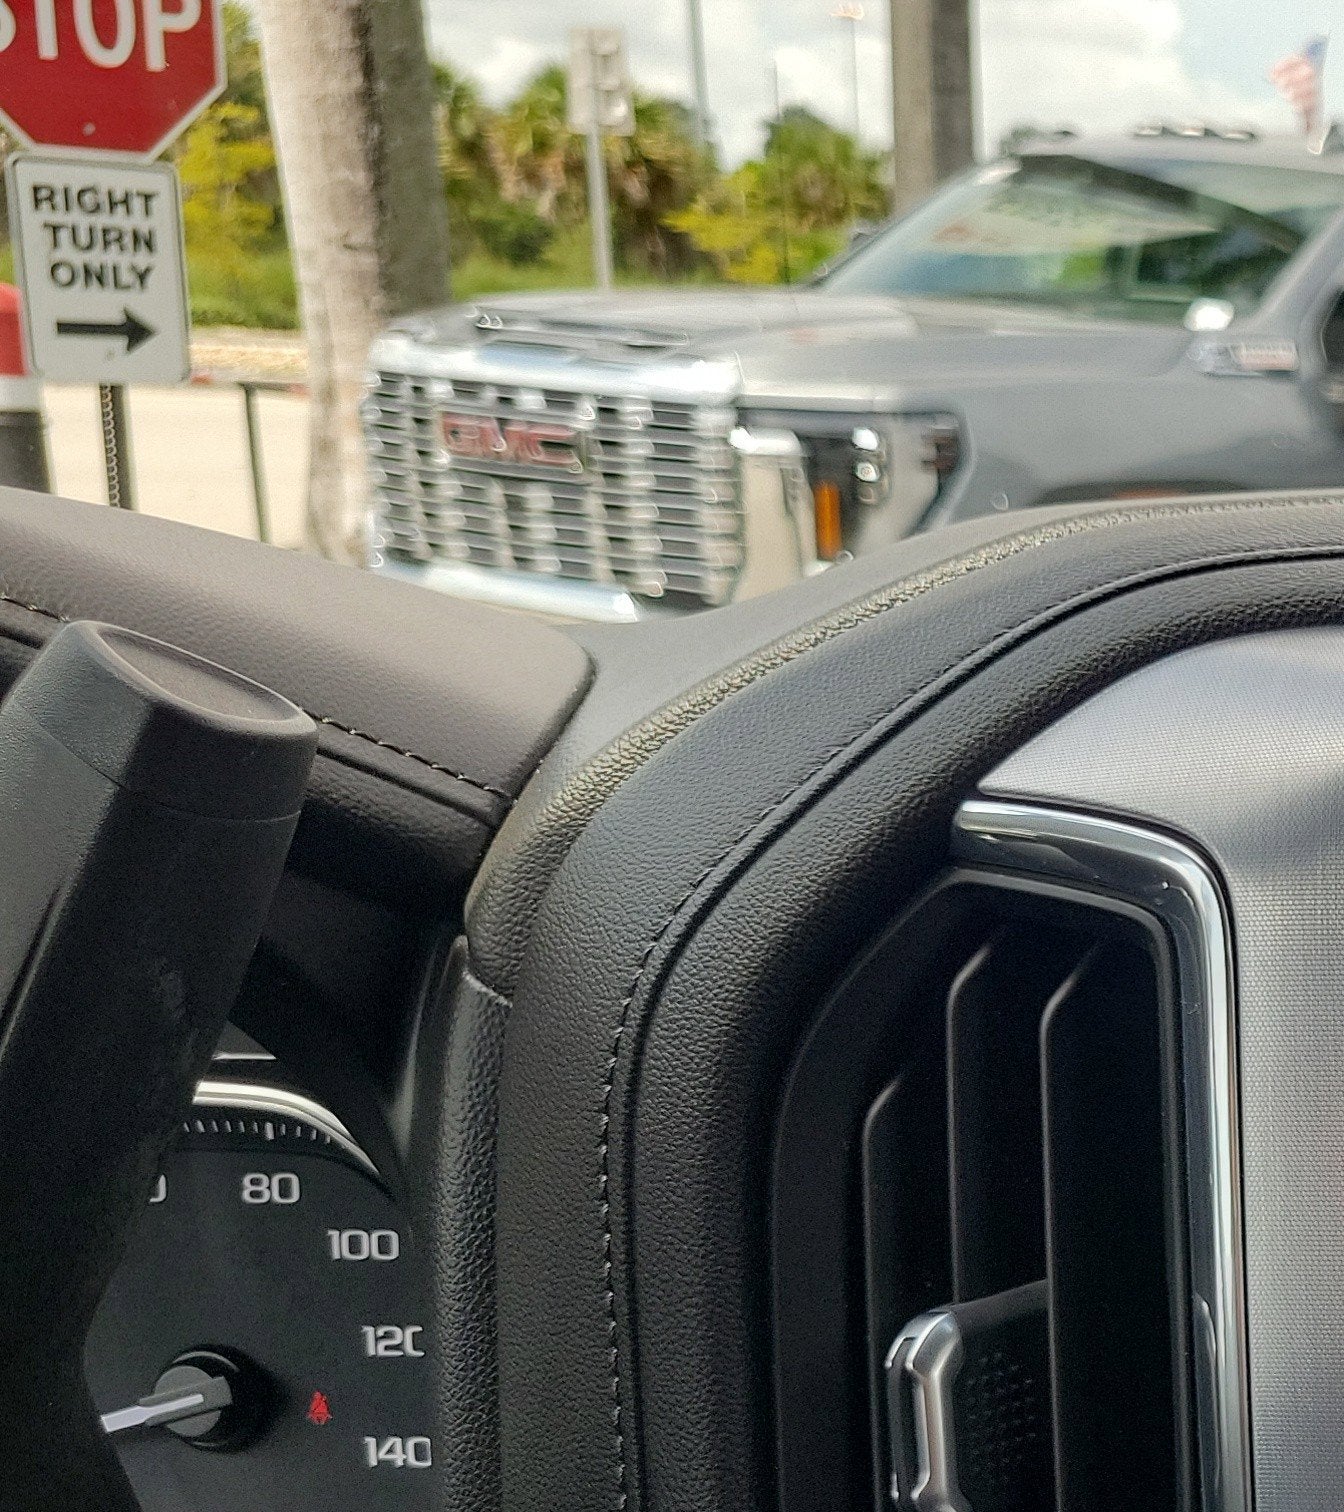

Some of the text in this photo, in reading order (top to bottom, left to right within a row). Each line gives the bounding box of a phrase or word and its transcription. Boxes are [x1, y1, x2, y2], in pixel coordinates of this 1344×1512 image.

[32, 184, 159, 216] RIGHT
[43, 222, 155, 257] TURN
[50, 261, 152, 291] ONLY
[242, 1173, 300, 1204] 80
[327, 1229, 399, 1260] 100
[364, 1436, 432, 1466] 140
